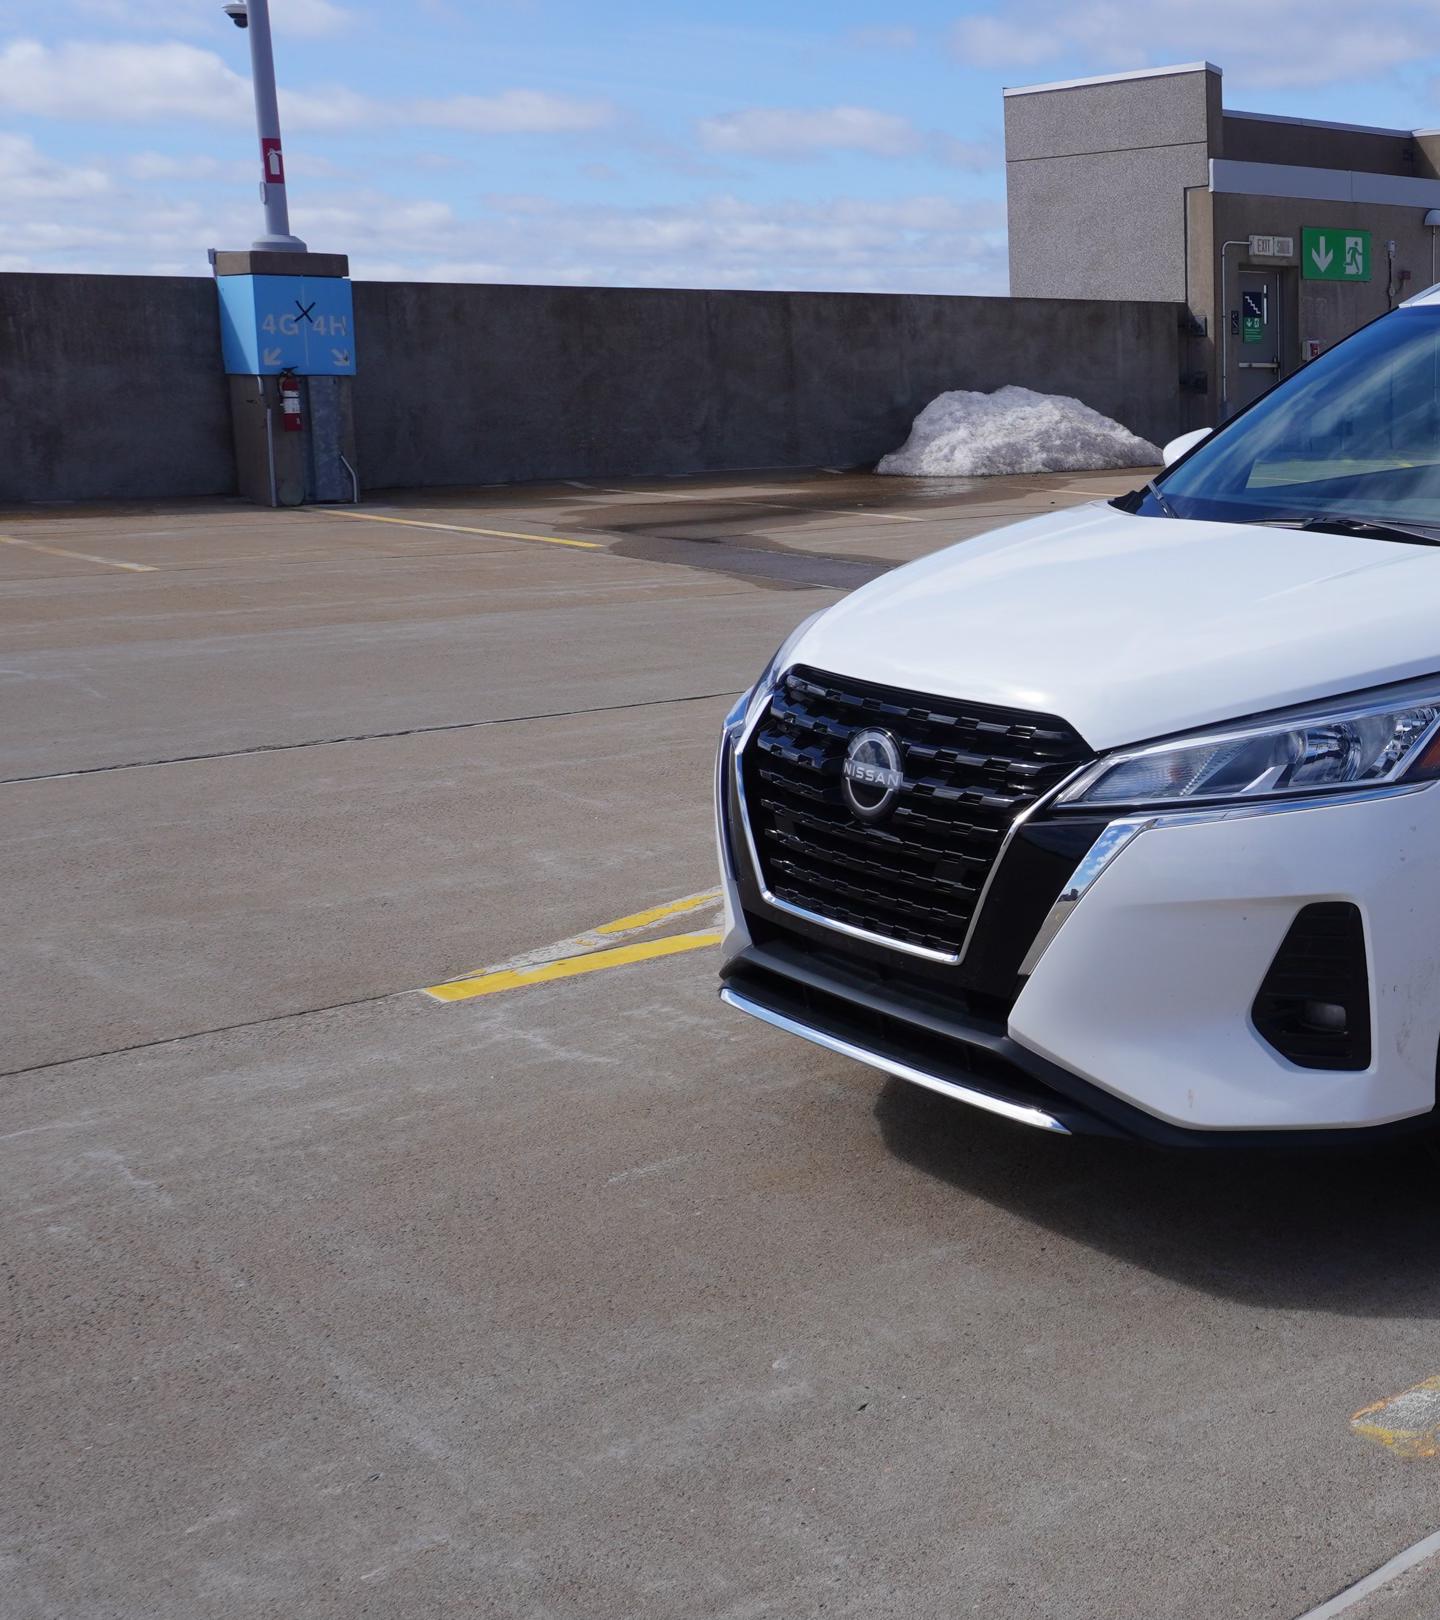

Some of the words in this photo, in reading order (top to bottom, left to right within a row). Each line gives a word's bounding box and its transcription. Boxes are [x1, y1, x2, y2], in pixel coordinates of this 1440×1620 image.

[262, 313, 299, 336] 4G
[312, 315, 347, 337] 4H
[843, 761, 900, 787] NISSAN
